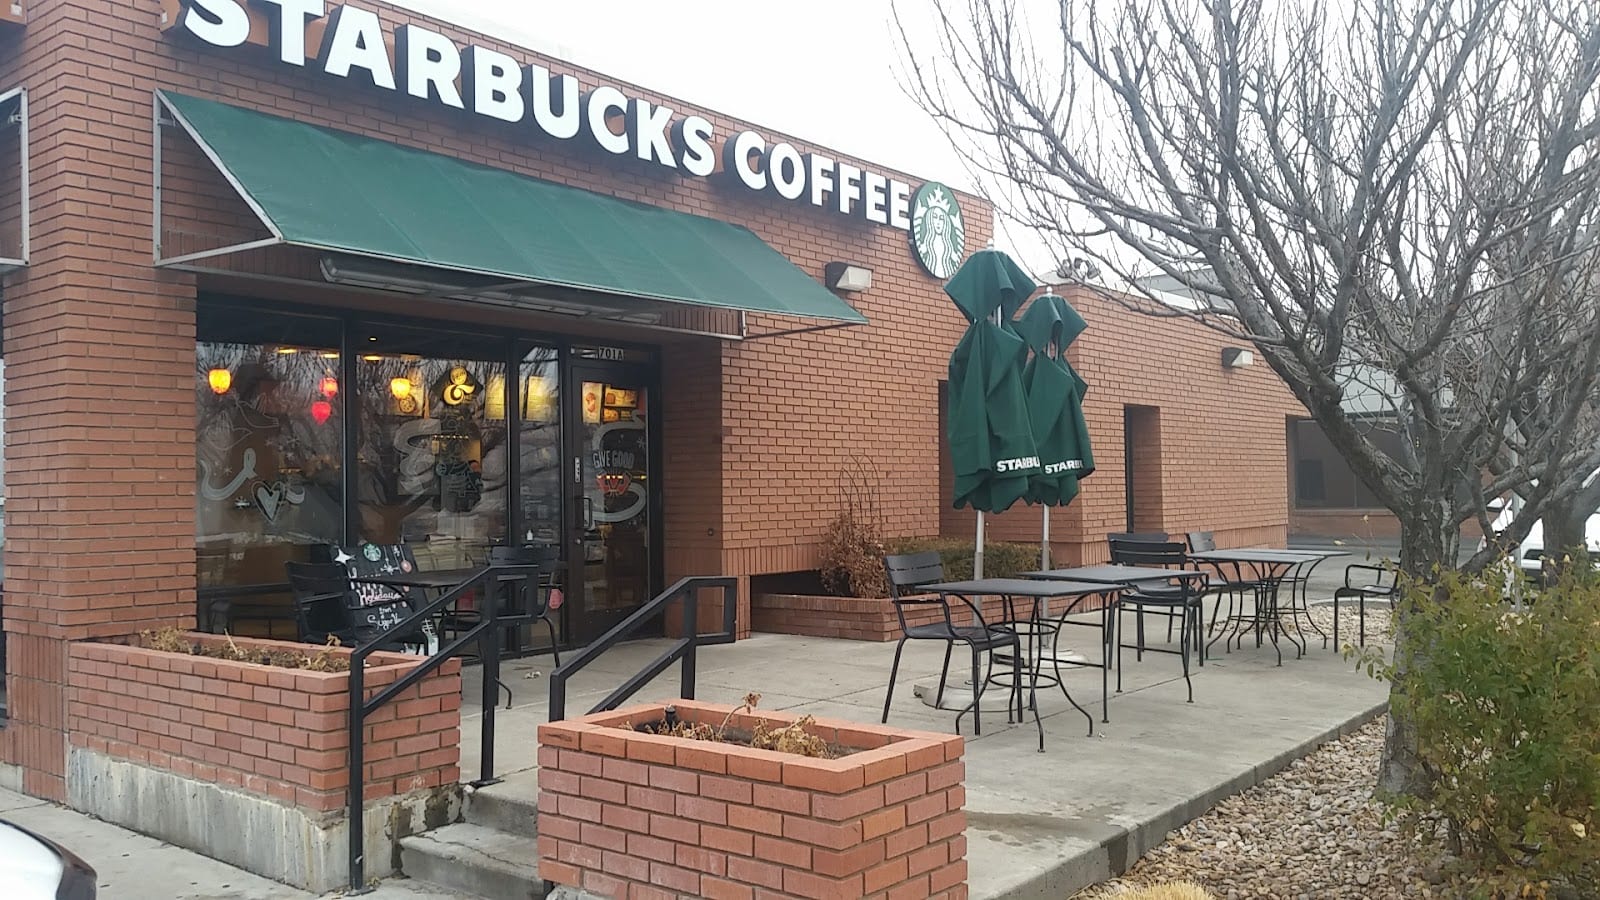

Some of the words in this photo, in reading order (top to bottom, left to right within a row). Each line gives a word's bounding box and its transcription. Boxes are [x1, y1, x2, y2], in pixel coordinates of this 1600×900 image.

[185, 0, 715, 176] STARBUCKS
[733, 131, 911, 231] COFFEE
[593, 450, 611, 468] GIVE
[613, 450, 635, 469] GOOD
